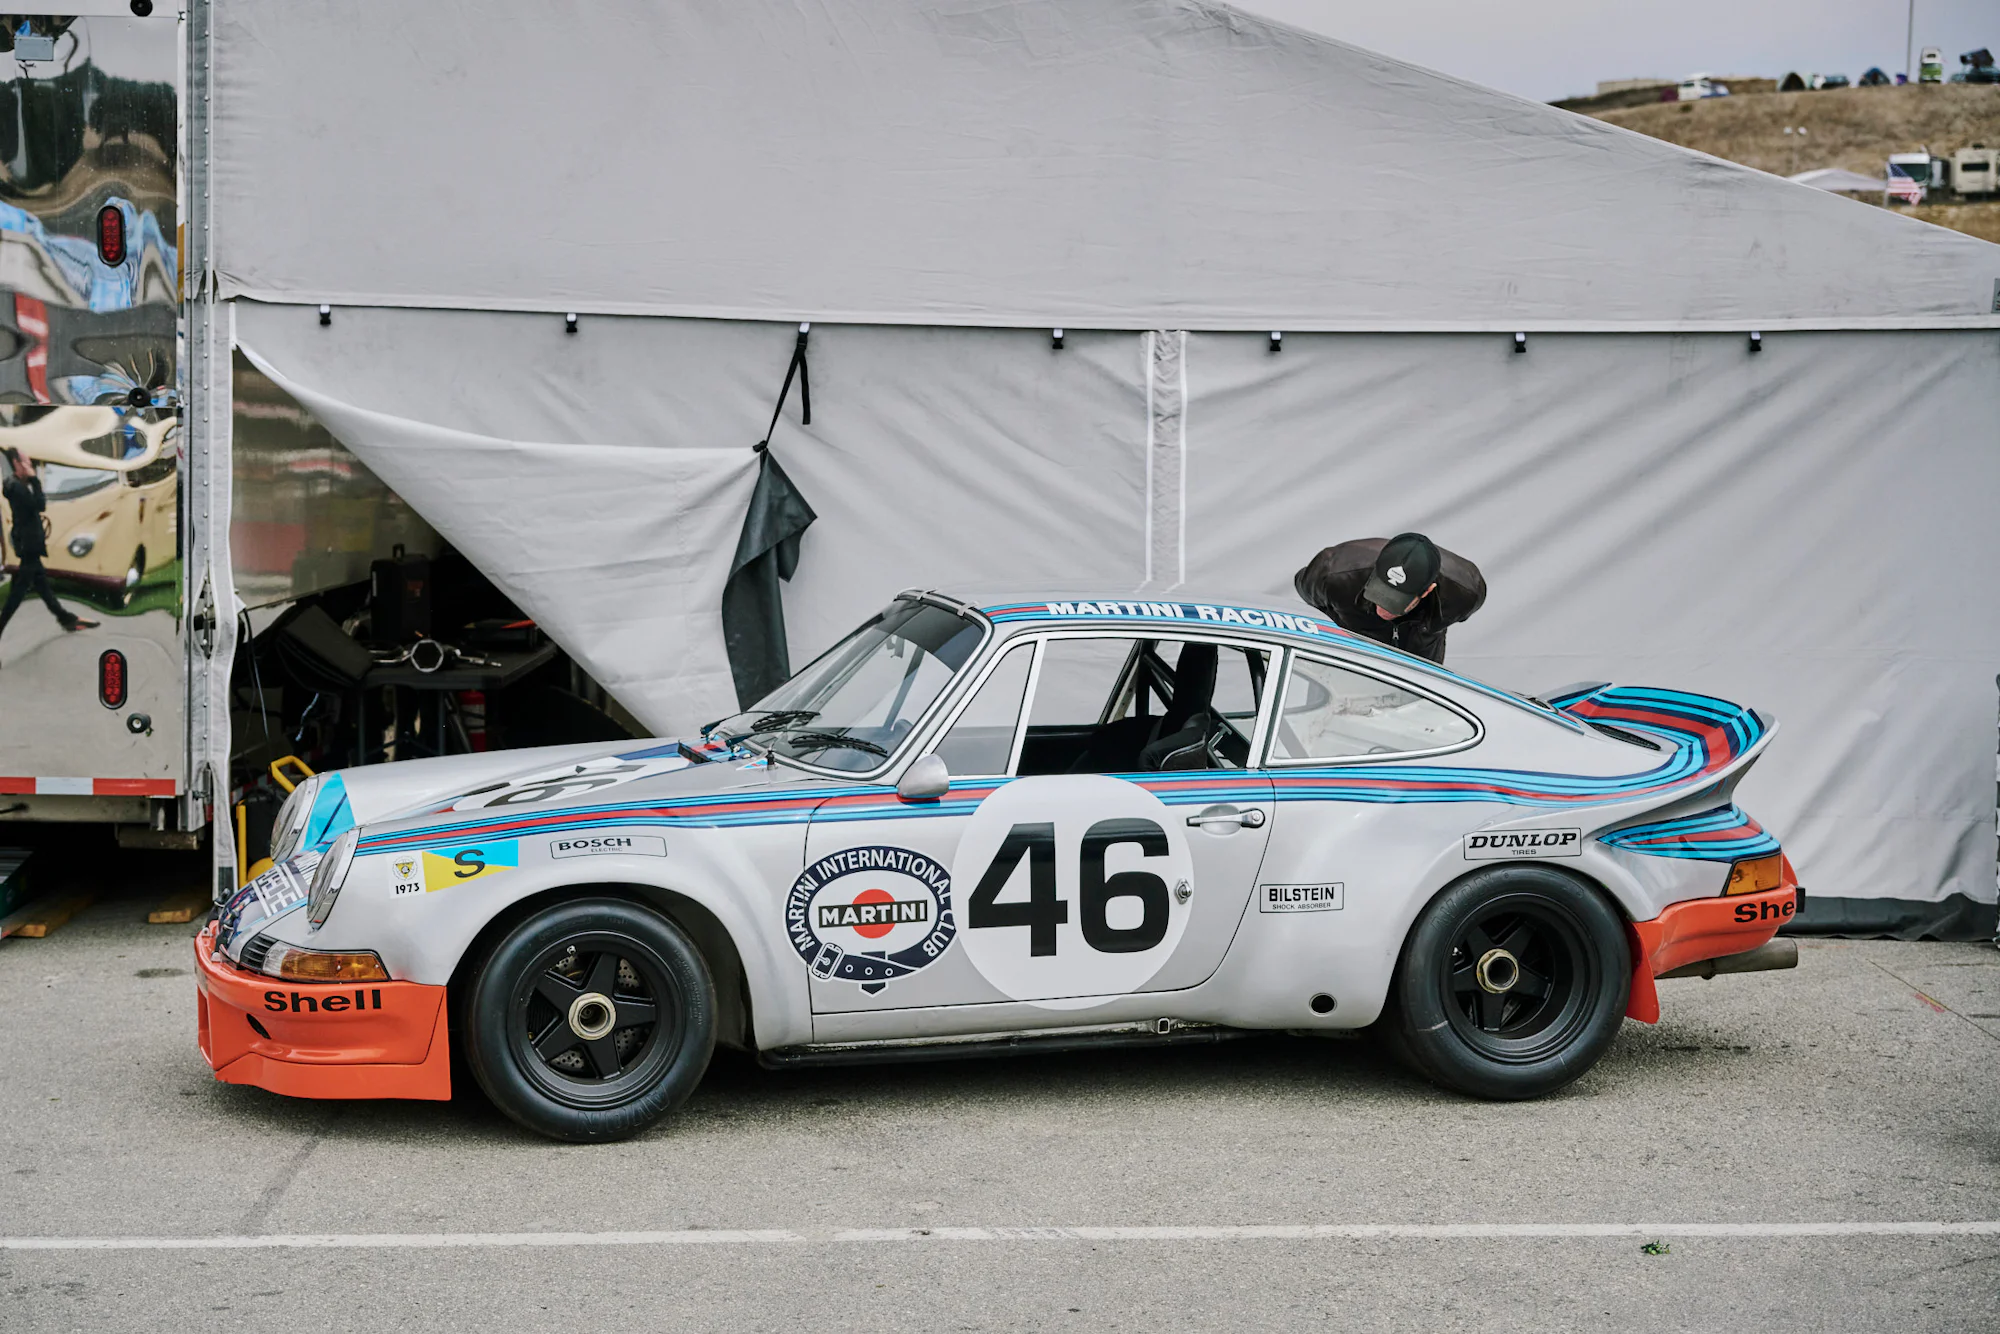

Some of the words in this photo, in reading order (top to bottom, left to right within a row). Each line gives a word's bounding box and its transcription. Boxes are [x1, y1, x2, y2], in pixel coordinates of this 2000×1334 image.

[1045, 602, 1185, 618] MARTINI
[1195, 604, 1320, 635] RACING
[558, 838, 632, 851] BOSCH
[1468, 832, 1577, 849] DUNLOP
[1511, 848, 1537, 856] TIRES
[453, 849, 486, 879] S
[395, 882, 420, 895] 1973
[968, 817, 1170, 957] 46
[1269, 886, 1334, 902] BILSTEIN
[788, 873, 819, 952] MARTINI
[815, 849, 951, 904] INTERNATIONAL
[922, 909, 955, 957] CLUB
[1297, 902, 1331, 910] ABSORBER
[821, 902, 926, 926] MARTINI
[264, 989, 382, 1012] Shell
